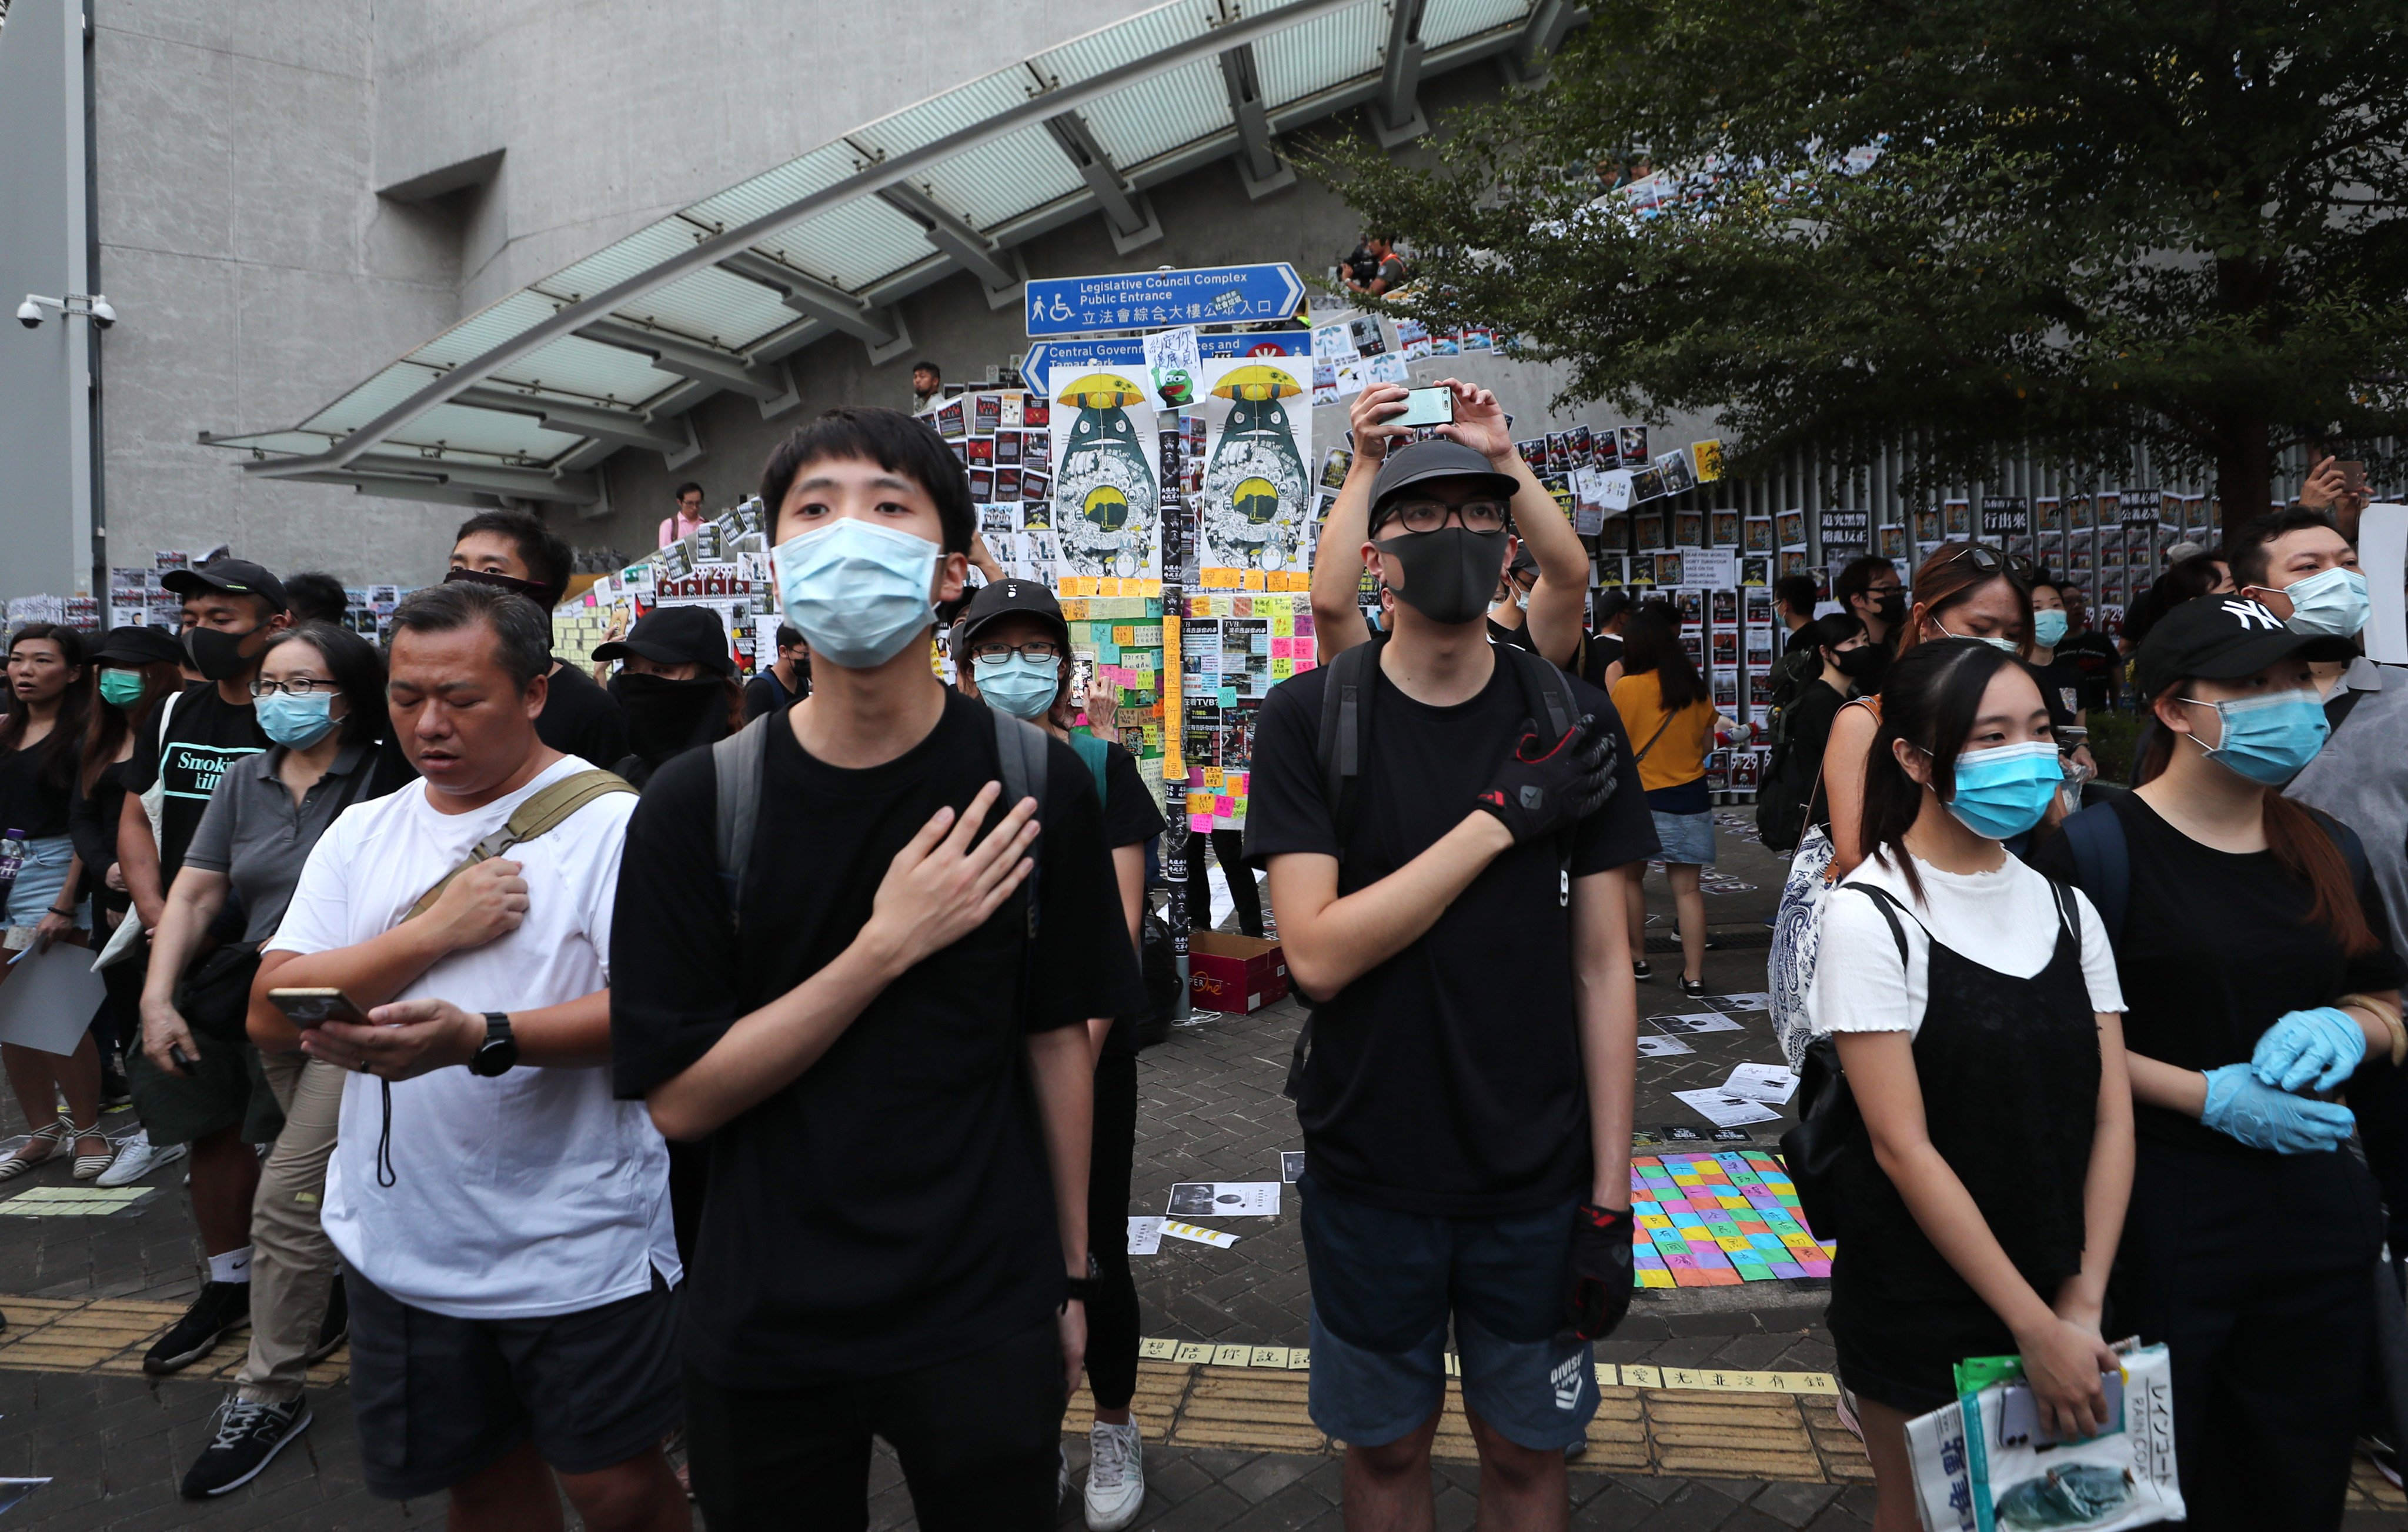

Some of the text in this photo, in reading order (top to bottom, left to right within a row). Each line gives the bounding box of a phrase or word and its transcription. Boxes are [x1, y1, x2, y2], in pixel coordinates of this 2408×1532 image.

[1080, 272, 1247, 293] Legislative Council Complex
[1080, 291, 1173, 306] Public Entrance
[1049, 345, 1092, 357] Central
[1217, 338, 1240, 349] and
[1150, 329, 1193, 355] 約定你
[1050, 358, 1114, 367] Tamar ark
[1822, 513, 1866, 526] 追究黑警
[1983, 512, 2026, 529] 行出來
[1822, 530, 1867, 543] 撥亂反正
[1550, 1349, 1584, 1385] DIVISI
[2130, 1396, 2143, 1432] RAIN
[2150, 1384, 2177, 1487] レインコート
